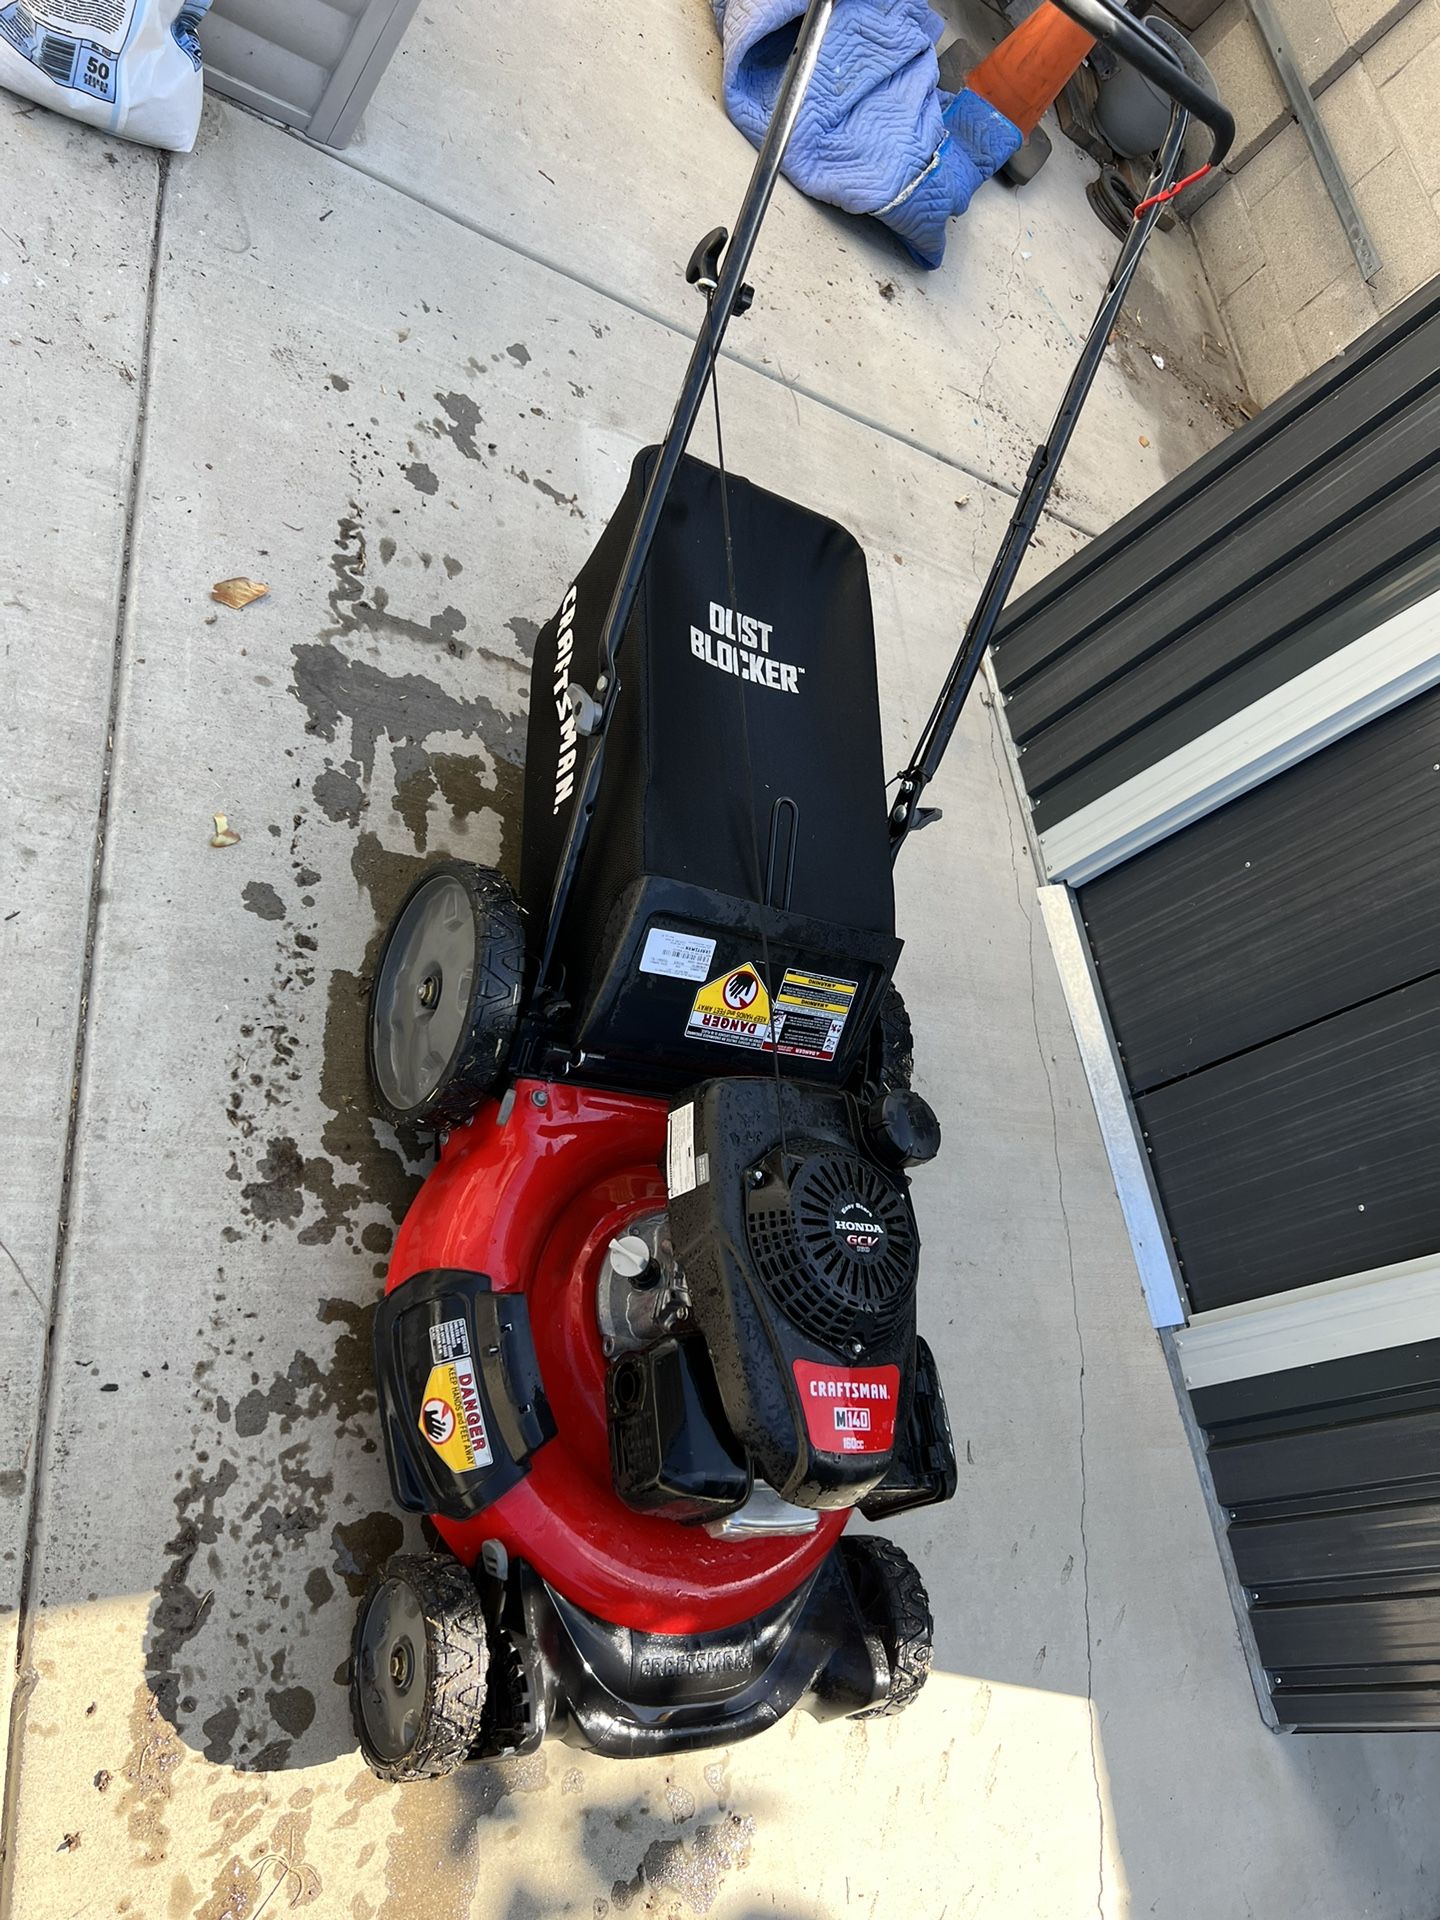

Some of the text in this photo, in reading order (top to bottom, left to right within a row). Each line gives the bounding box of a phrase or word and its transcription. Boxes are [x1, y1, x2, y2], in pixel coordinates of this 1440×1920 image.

[86, 56, 110, 80] 50
[709, 601, 773, 653] DUST
[697, 1004, 713, 1013] AWAY
[714, 1007, 726, 1016] FEET
[736, 1011, 754, 1020] HANDS
[702, 1014, 757, 1034] DANGER
[753, 1015, 767, 1023] KEEP
[835, 1220, 884, 1234] HONDA
[847, 1234, 879, 1247] GCV
[448, 1367, 474, 1465] KEEP HANDS and FEET AWAY
[458, 1373, 486, 1451] DANGER
[835, 1410, 868, 1429] M140
